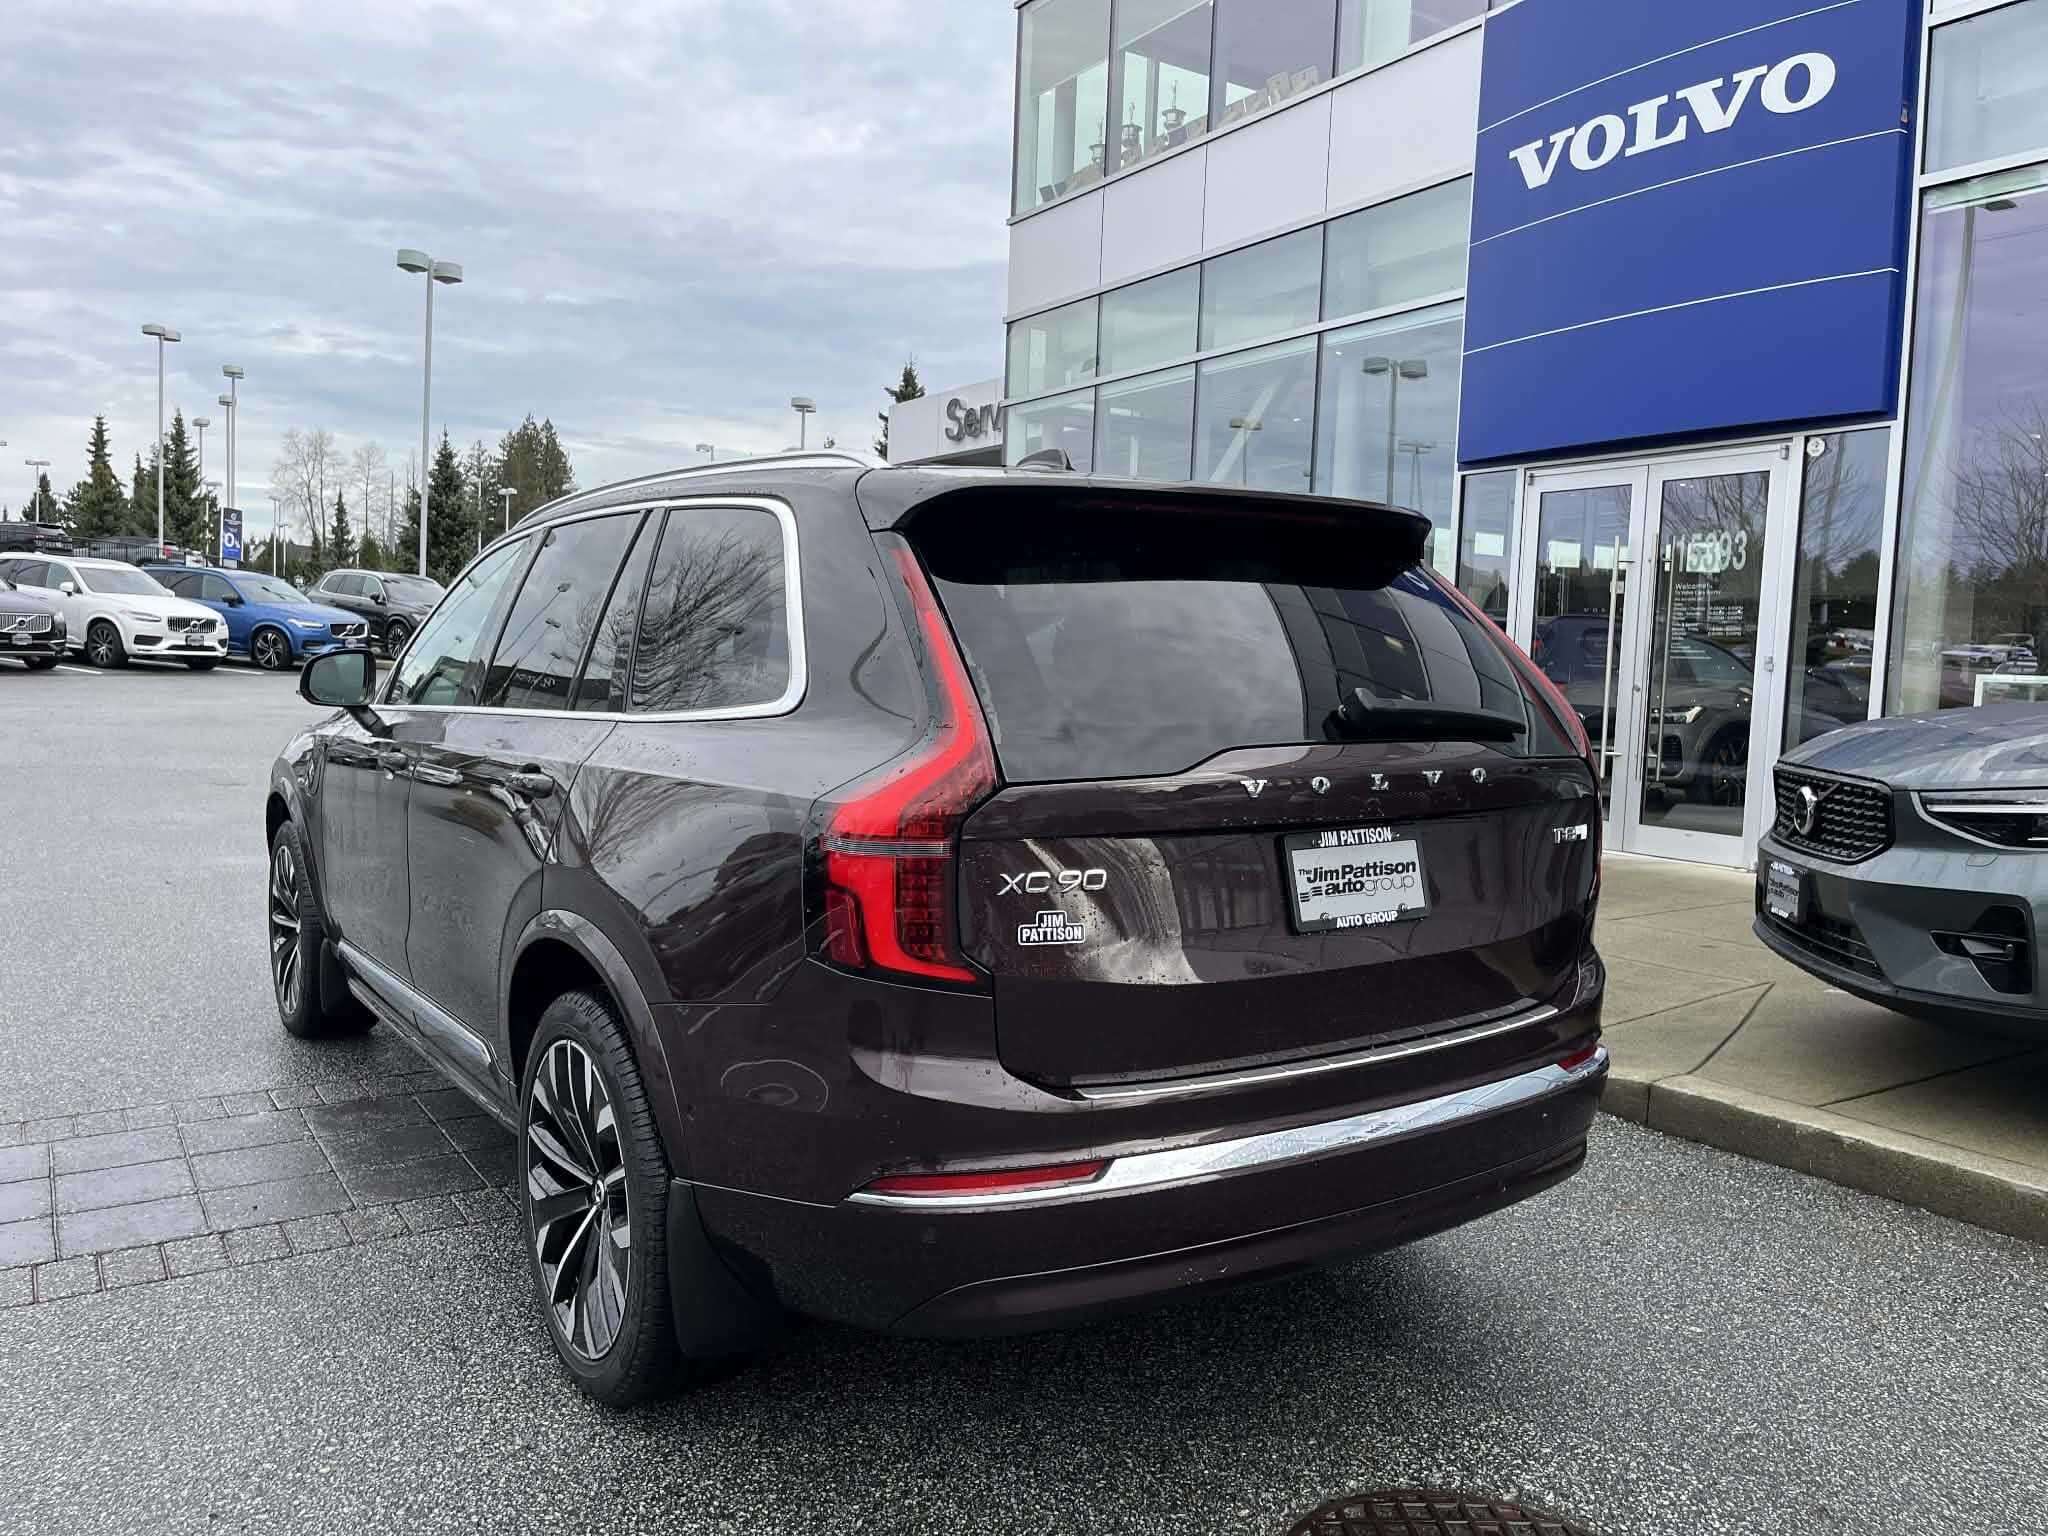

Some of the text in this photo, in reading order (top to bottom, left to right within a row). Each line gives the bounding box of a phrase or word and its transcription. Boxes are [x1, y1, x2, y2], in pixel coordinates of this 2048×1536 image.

[1509, 52, 1836, 190] VOLVO
[1240, 767, 1487, 797] VOLVO
[1320, 826, 1392, 847] JIM PATTISON
[1040, 914, 1064, 928] JIM
[1336, 910, 1398, 929] AUTO GROUP
[1022, 926, 1082, 942] PATTISON
